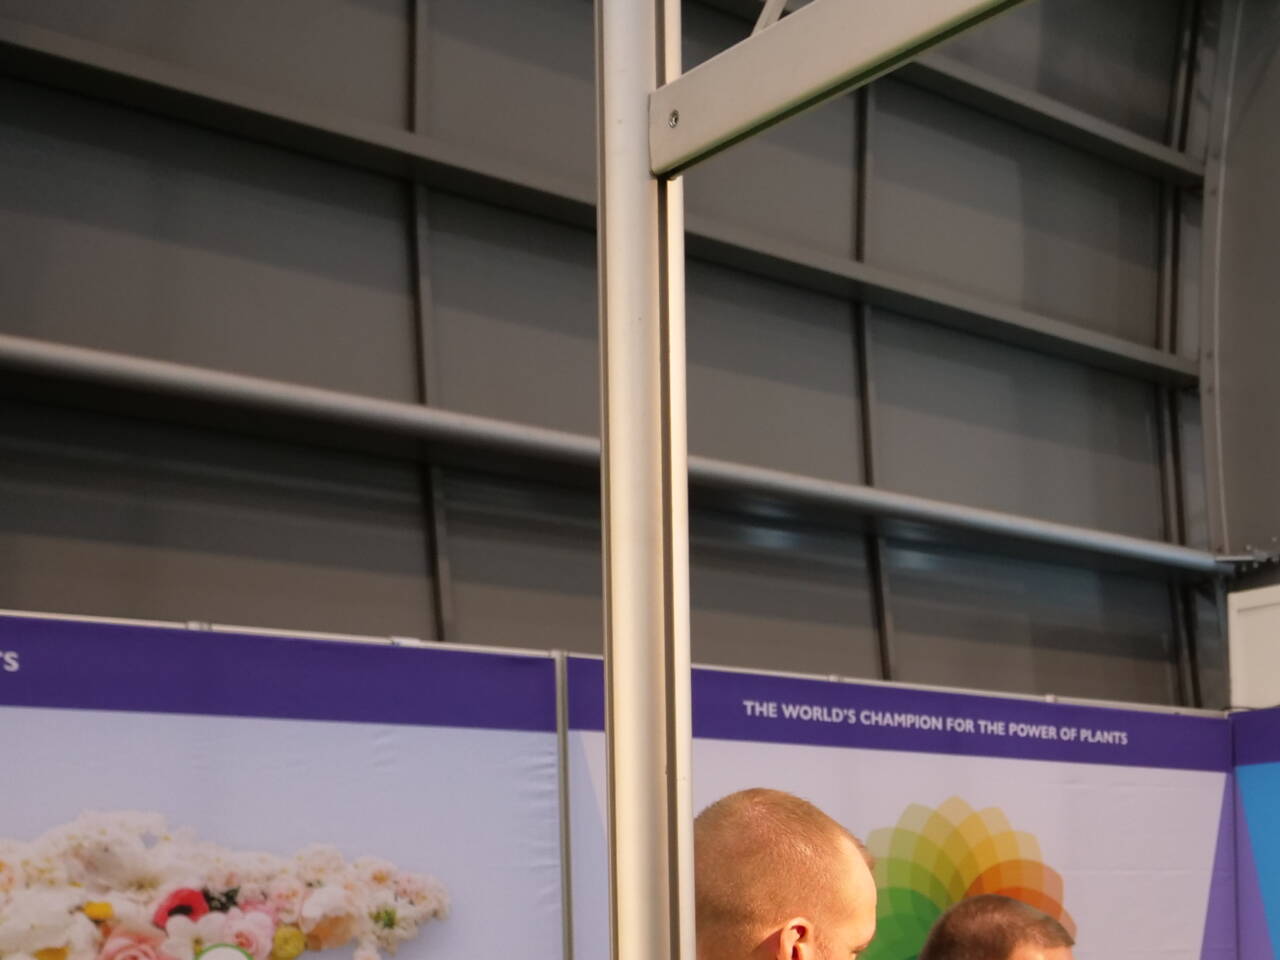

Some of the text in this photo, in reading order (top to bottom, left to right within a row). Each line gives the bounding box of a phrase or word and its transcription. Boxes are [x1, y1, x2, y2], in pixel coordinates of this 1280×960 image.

[743, 700, 1129, 746] THE WORLD'S CHAMPION FOR THE POWER OF PLANTS
